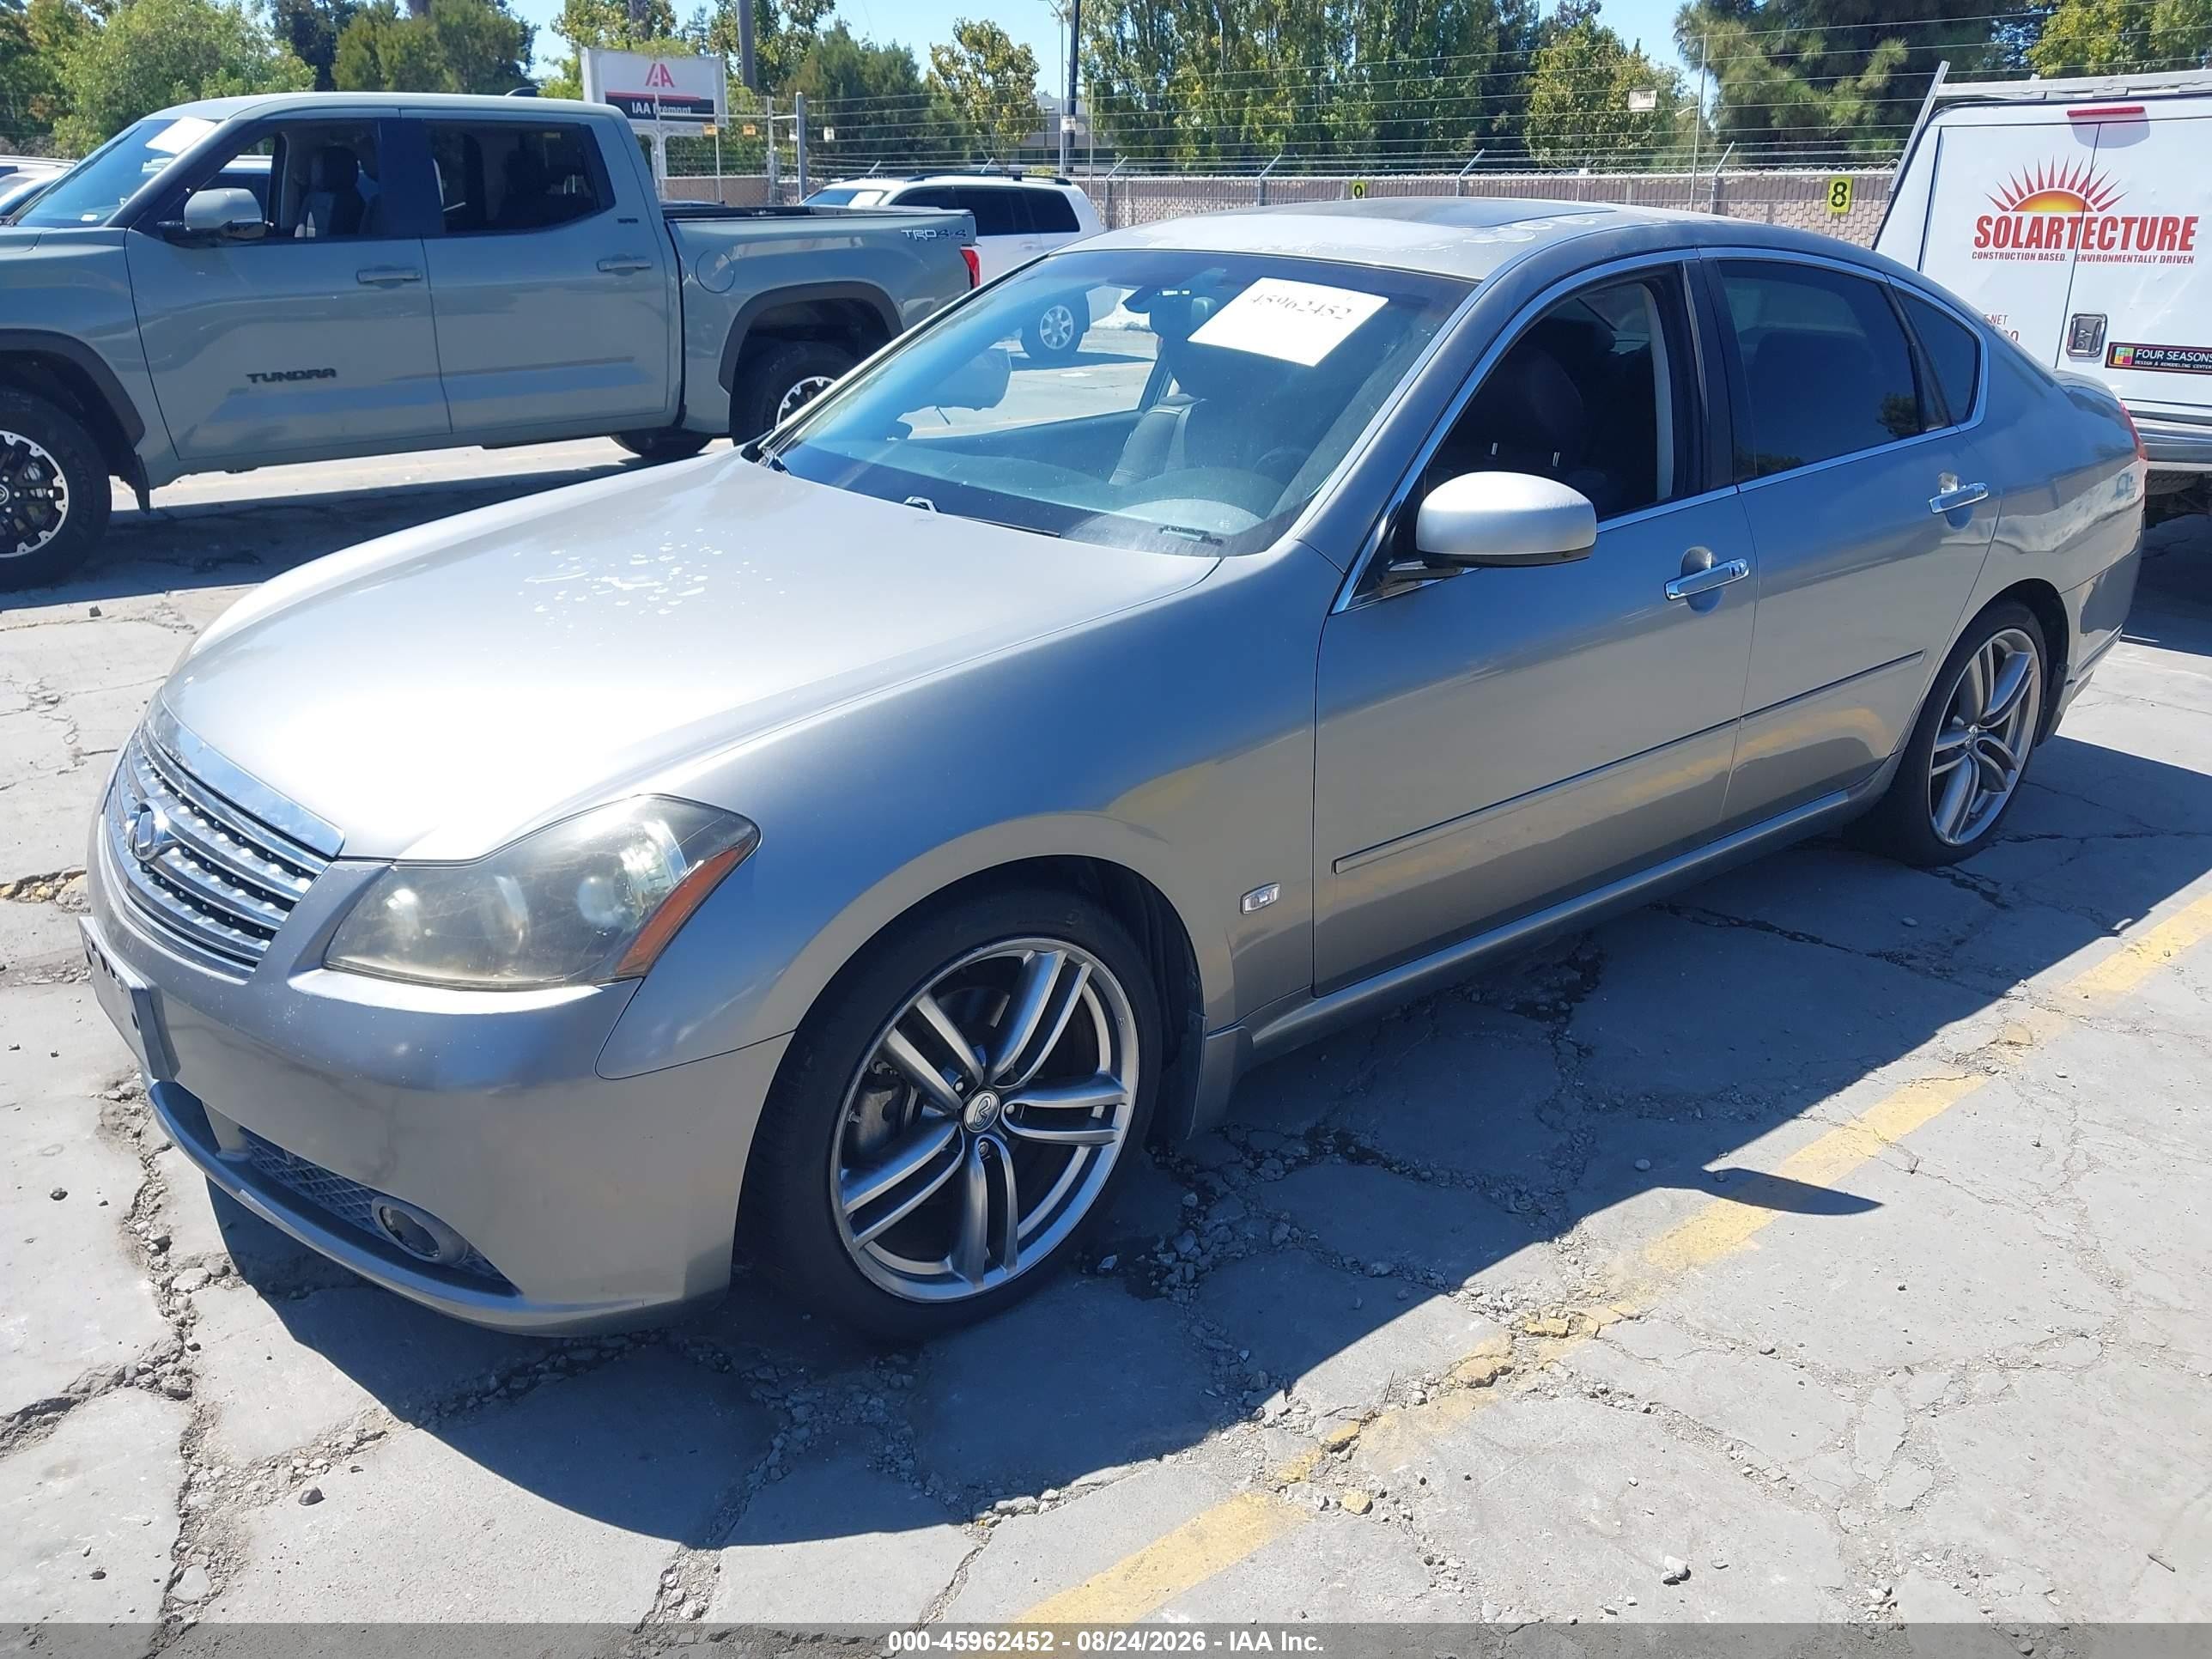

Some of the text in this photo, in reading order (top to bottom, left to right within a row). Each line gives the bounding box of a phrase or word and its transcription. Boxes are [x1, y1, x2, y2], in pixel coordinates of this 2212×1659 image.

[632, 101, 651, 114] IAA
[1831, 181, 1848, 208] 8
[1973, 216, 2199, 252] SOLARTECTURE
[1972, 251, 2195, 264] CONSTRUCTION BASED. ENVIRONMENTALLY DRIVEN
[2136, 349, 2165, 360] FOUR
[246, 368, 337, 383] TUNDRA
